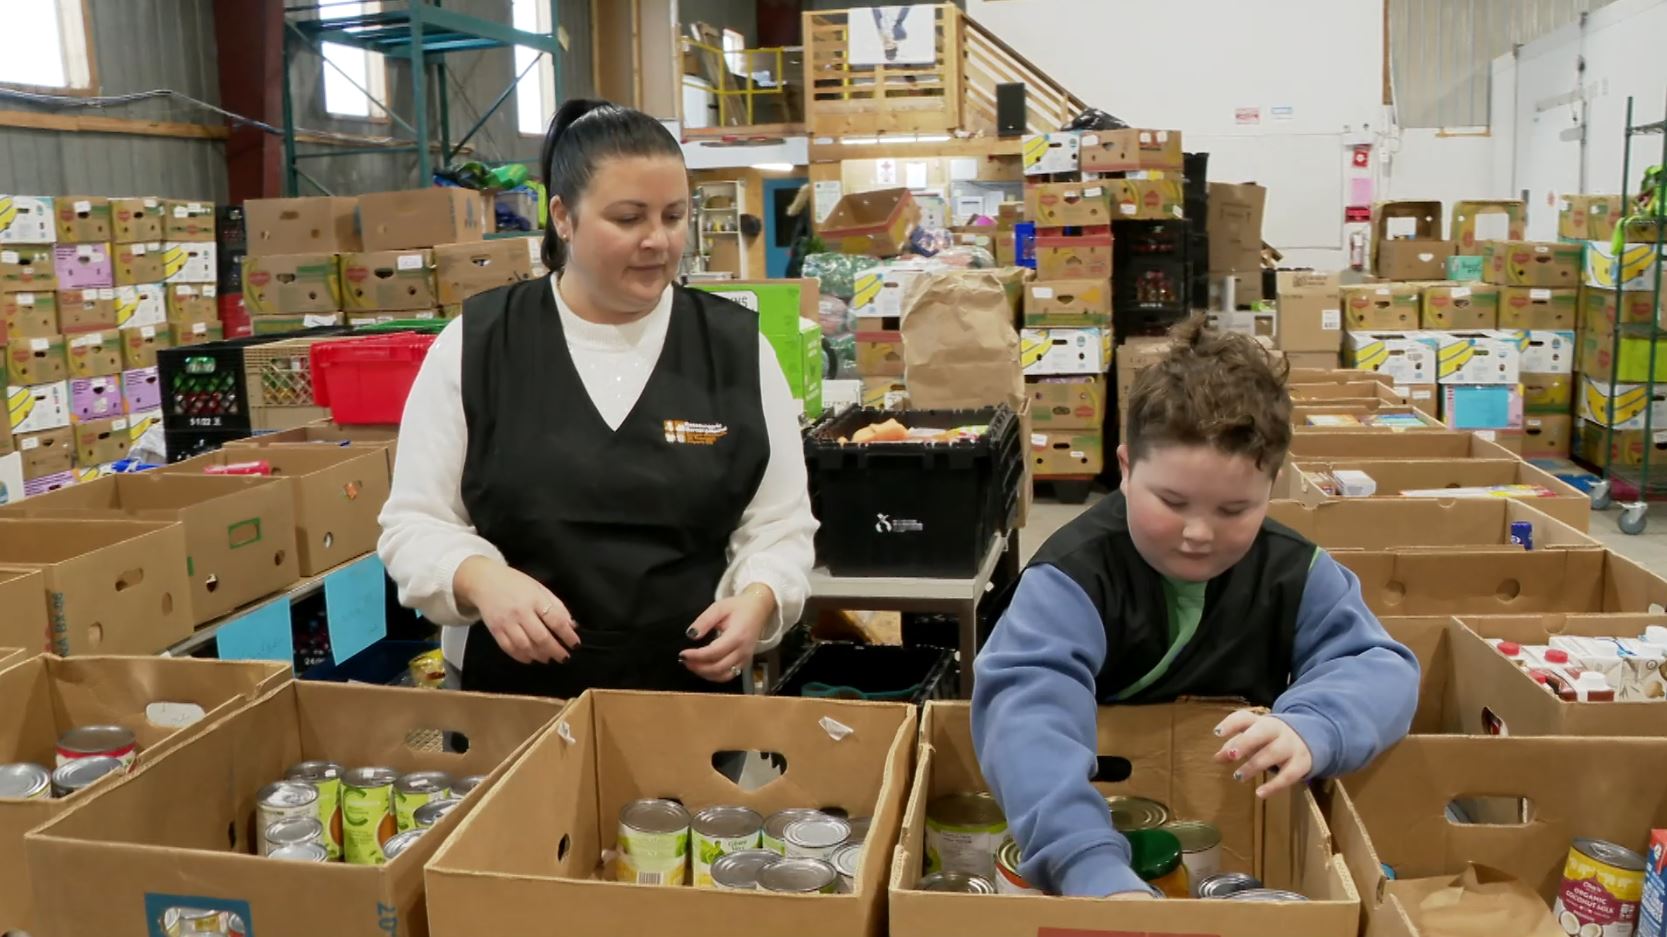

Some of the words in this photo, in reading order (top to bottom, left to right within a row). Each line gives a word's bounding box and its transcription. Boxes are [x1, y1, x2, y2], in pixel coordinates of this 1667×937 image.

[1565, 889, 1597, 909] COCONUT
[1597, 903, 1615, 914] MILK
[1573, 887, 1608, 905] ORGANIC
